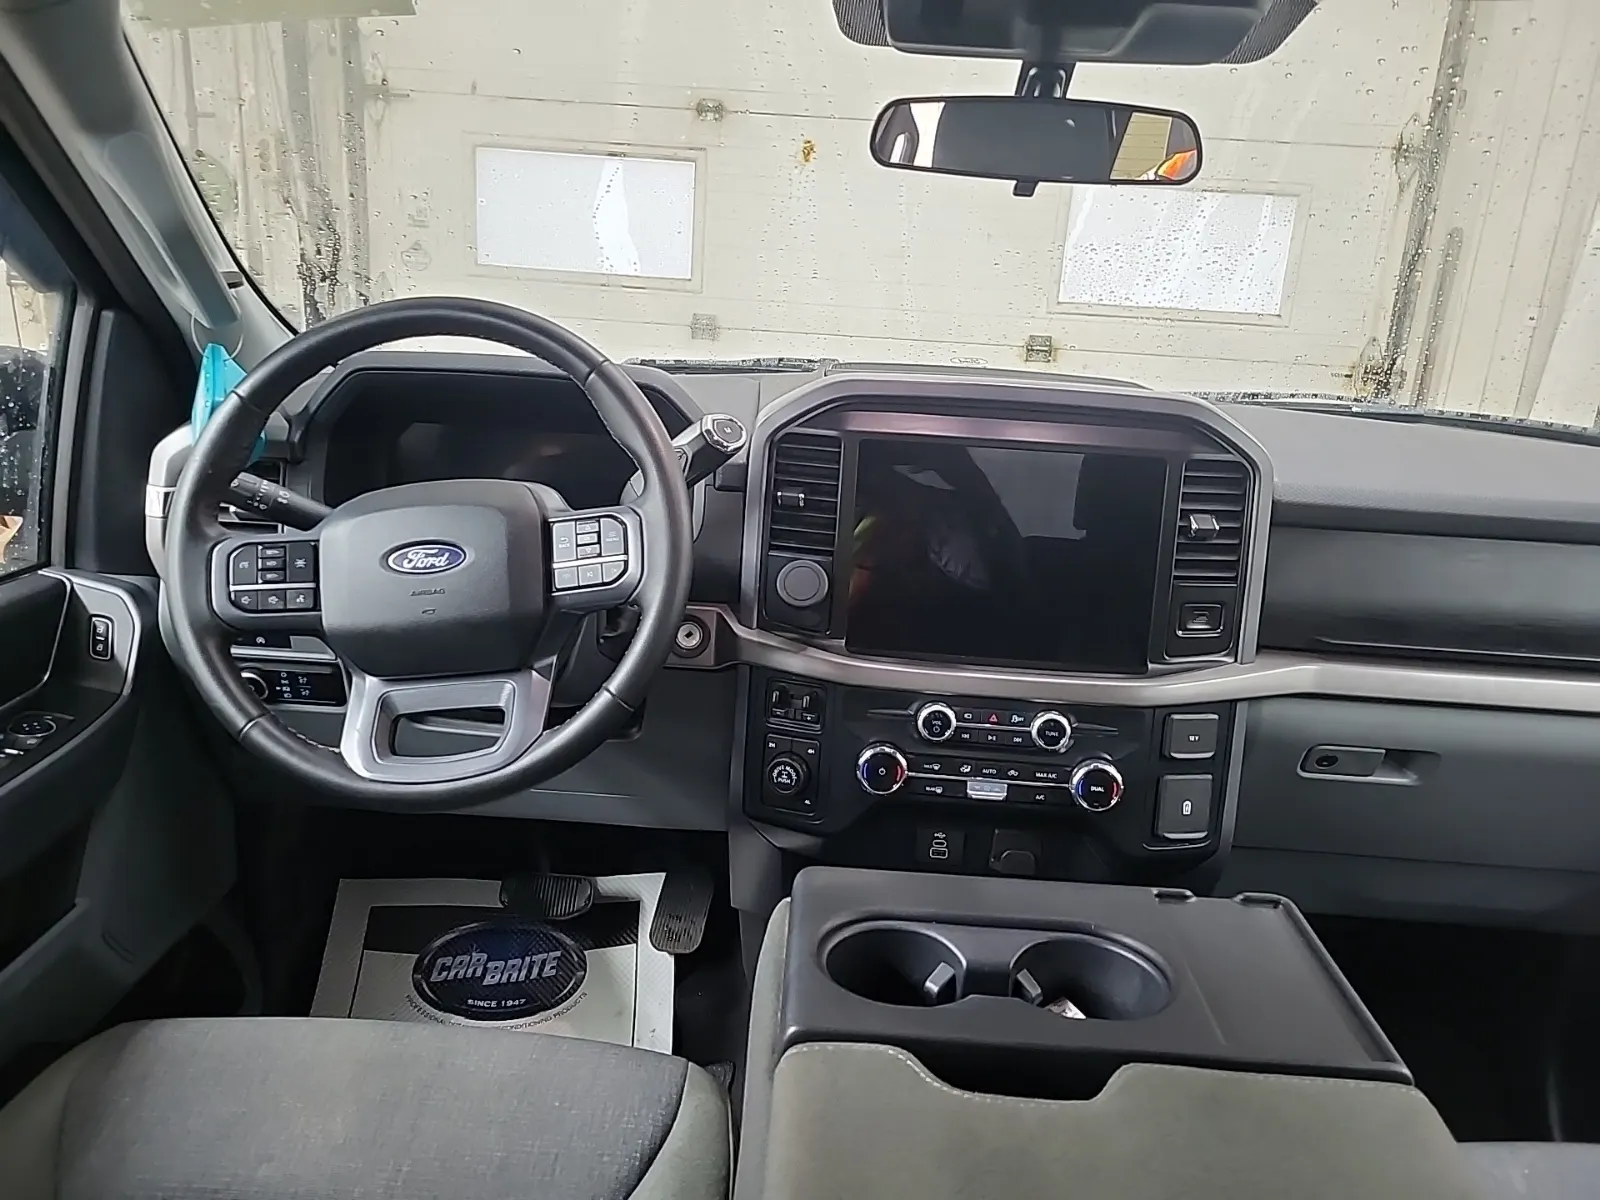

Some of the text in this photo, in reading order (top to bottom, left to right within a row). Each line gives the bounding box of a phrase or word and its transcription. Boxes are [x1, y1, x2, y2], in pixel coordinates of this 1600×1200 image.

[402, 548, 450, 569] Ford
[430, 951, 562, 986] CAR BRITE
[467, 998, 527, 1008] SINCE 1947
[553, 991, 588, 1019] PRODUCTS
